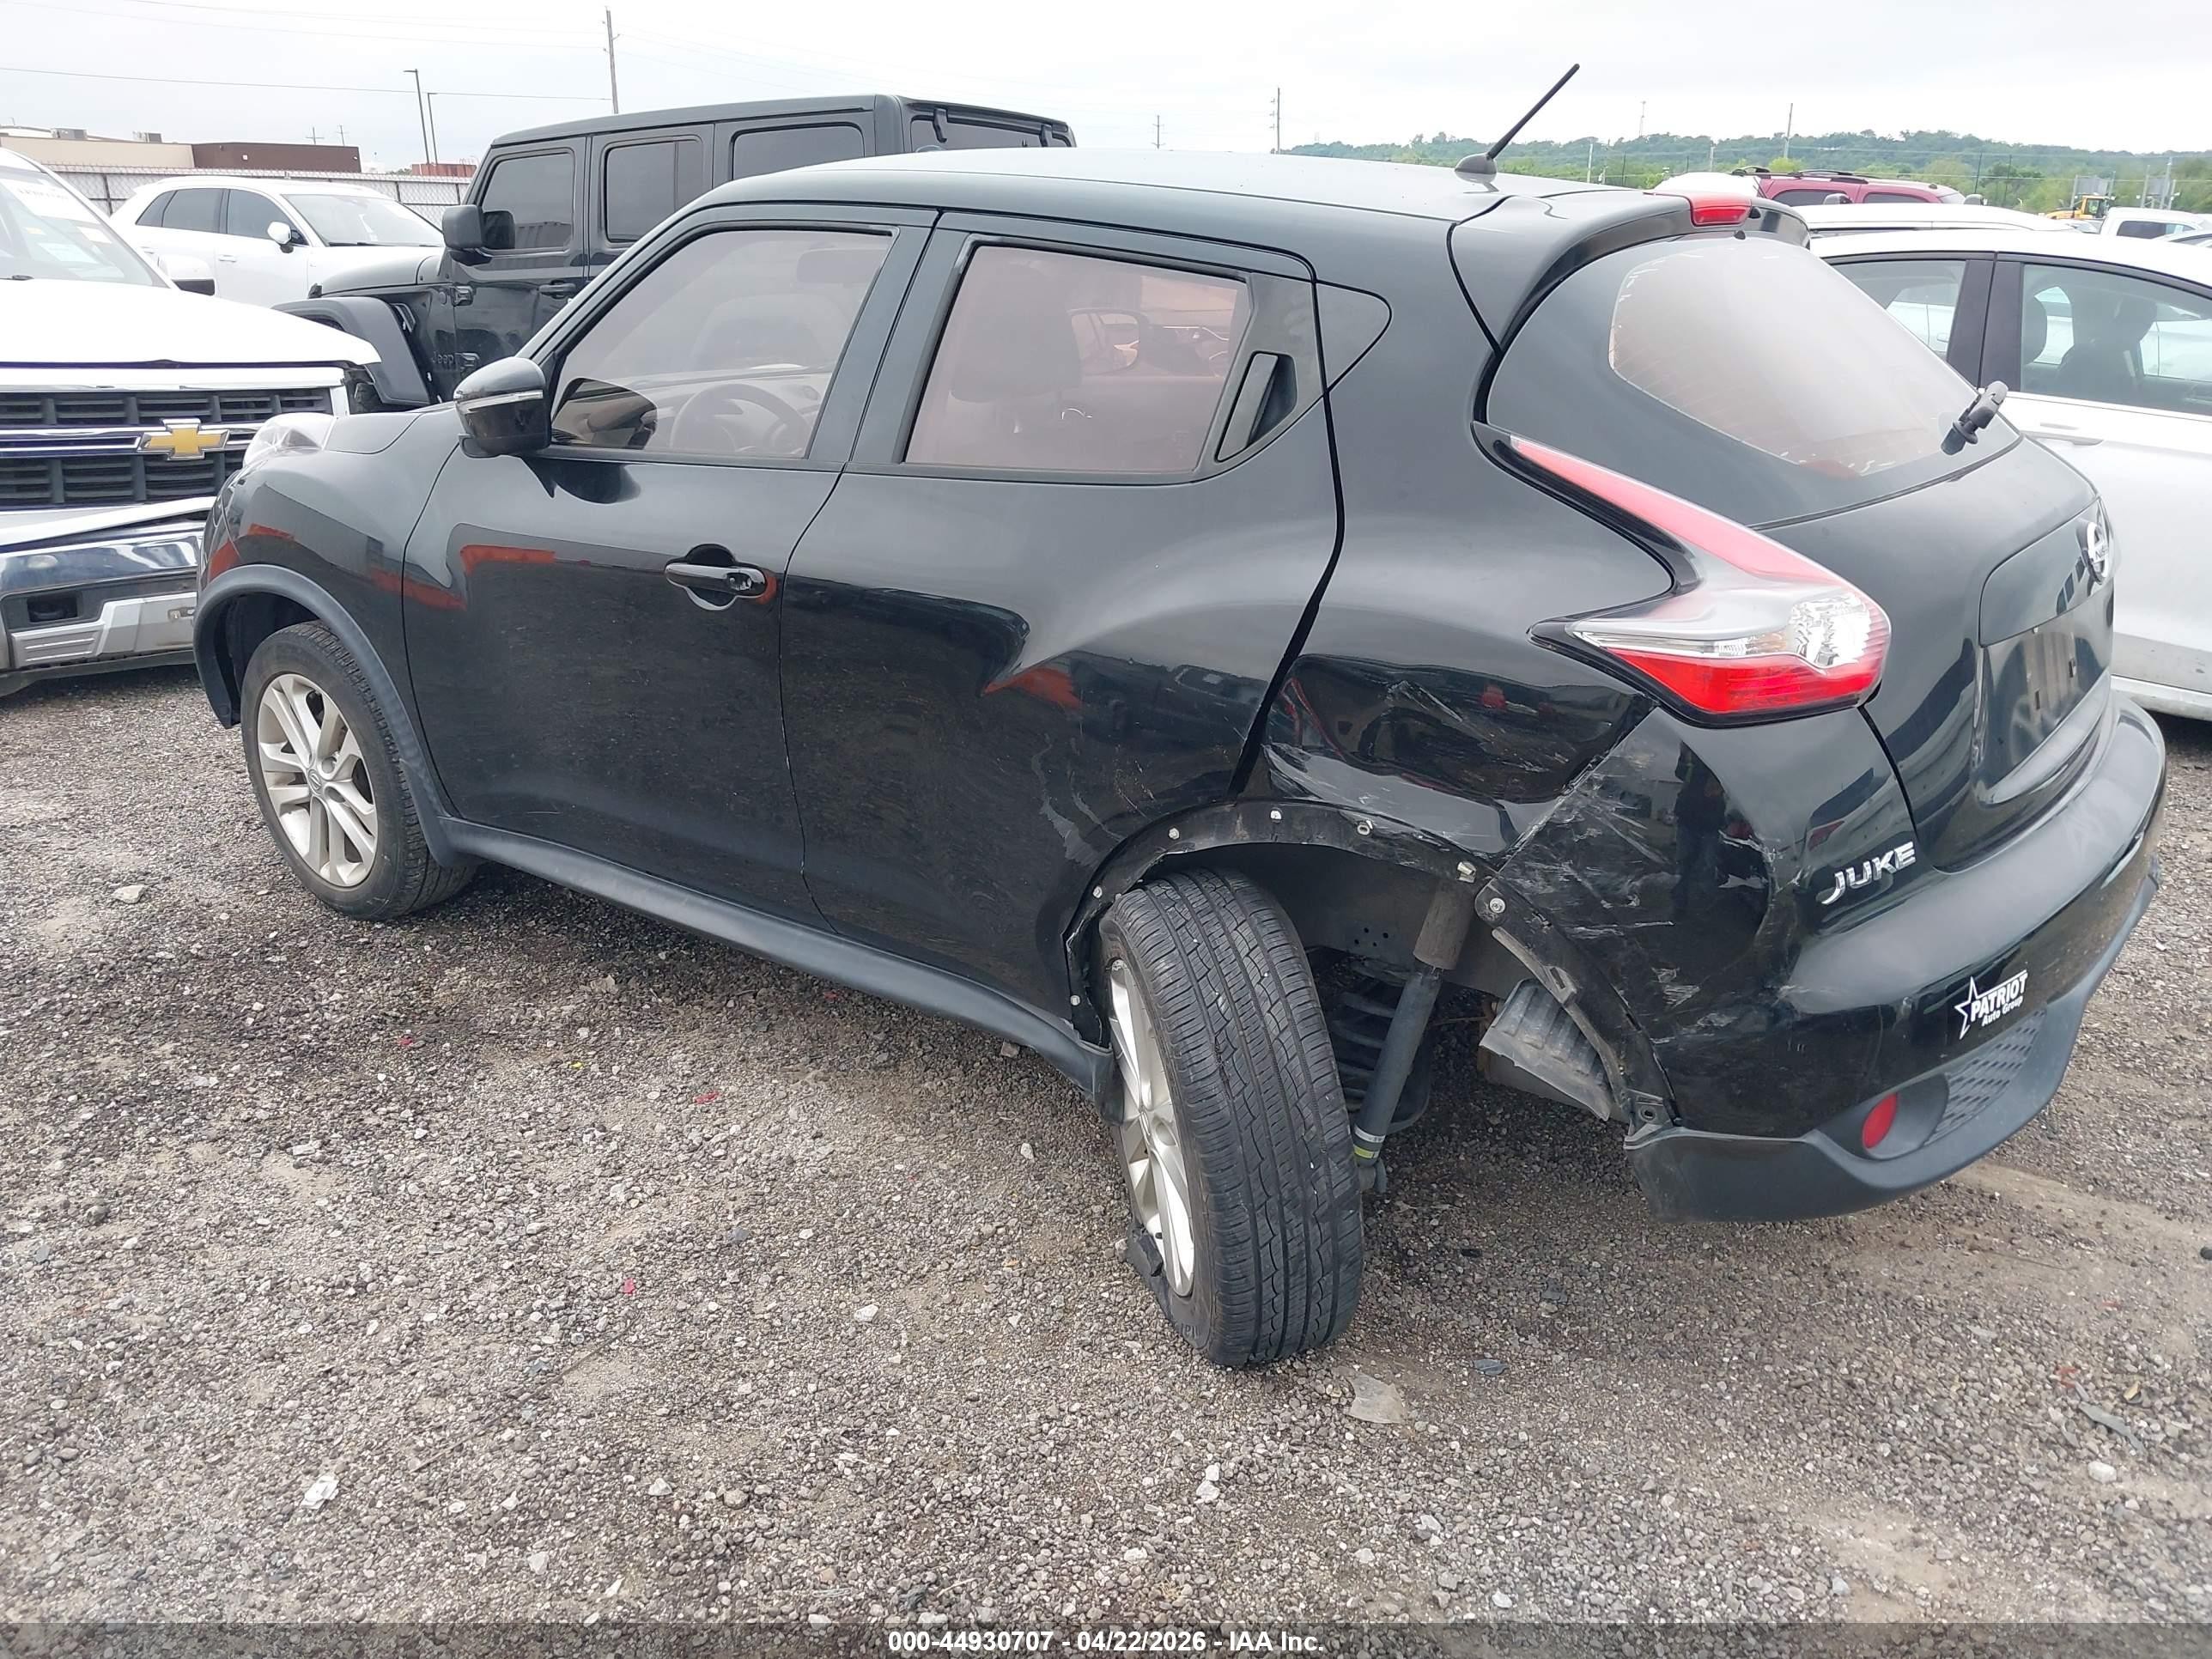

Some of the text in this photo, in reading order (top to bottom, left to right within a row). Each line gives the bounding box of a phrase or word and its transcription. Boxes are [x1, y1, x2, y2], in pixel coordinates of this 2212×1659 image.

[431, 351, 454, 367] Jeep
[1821, 841, 1917, 905] JUKE
[1970, 972, 2029, 1022] PATRIOT
[1981, 995, 2024, 1027] Auto Group
